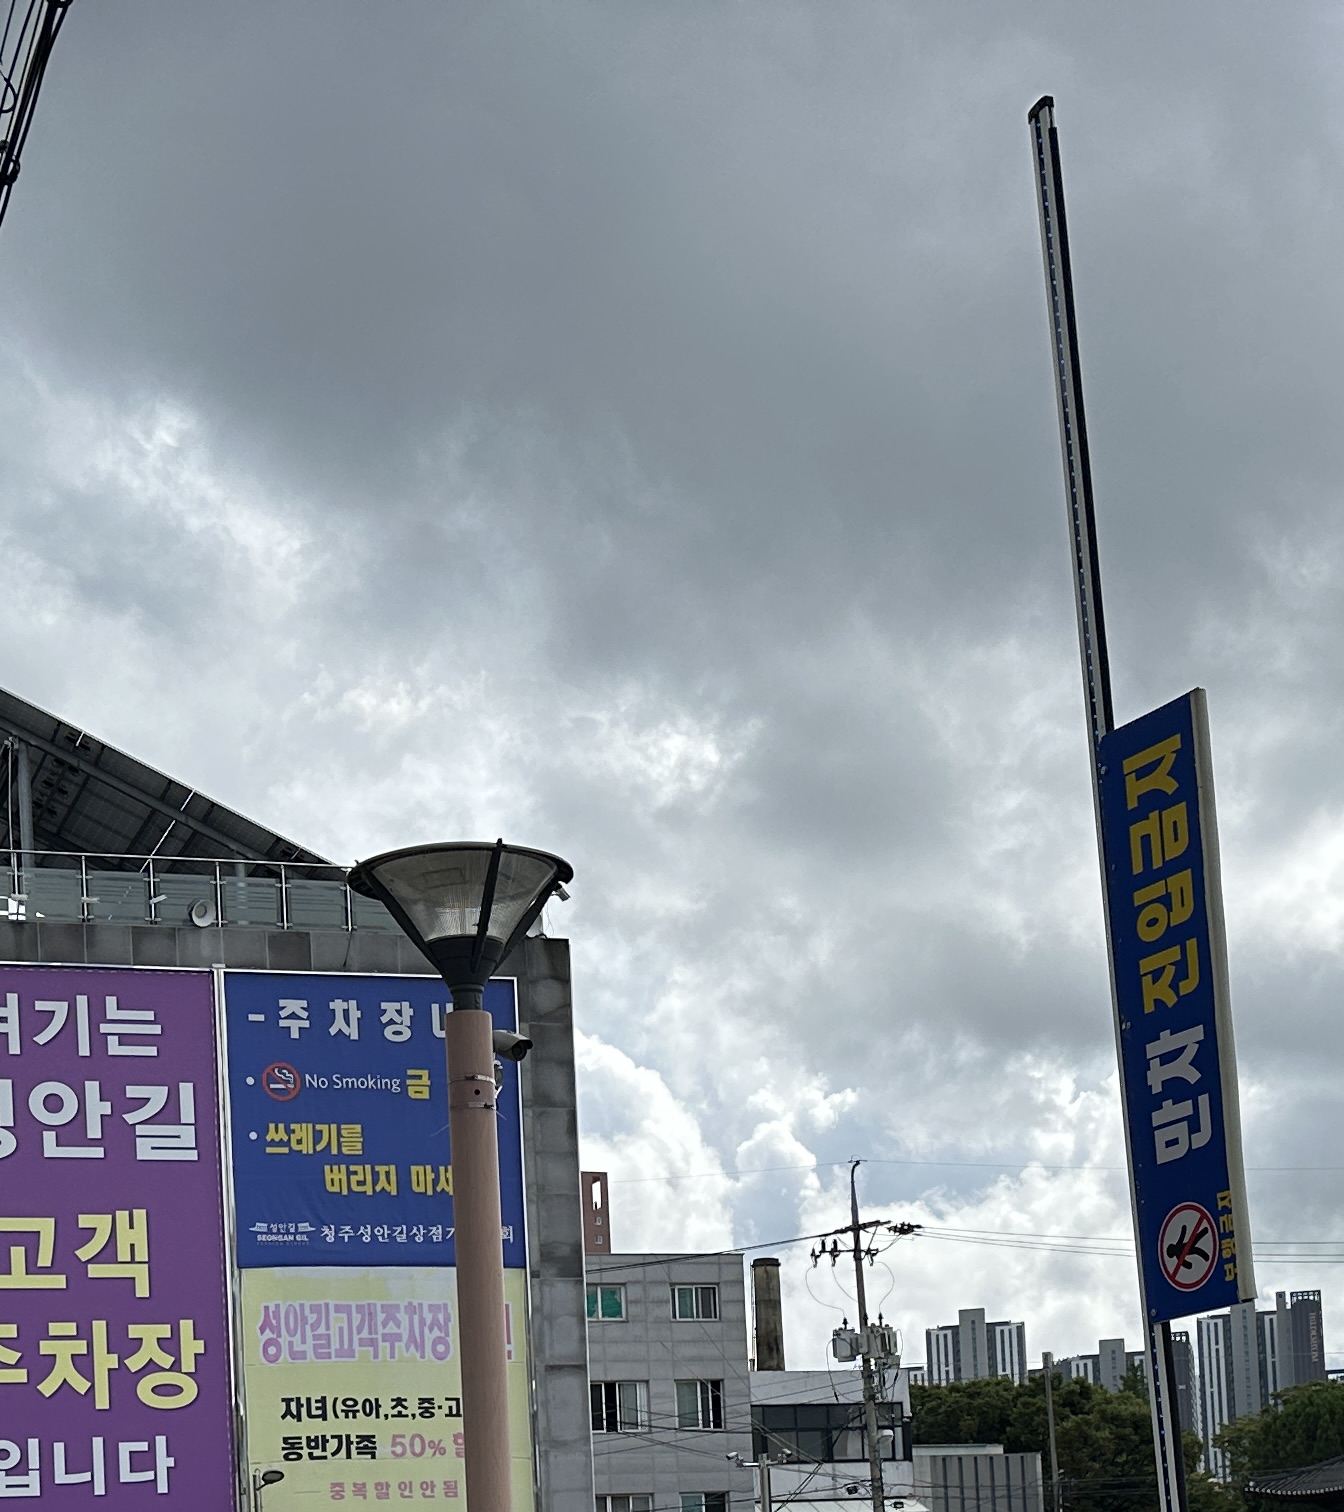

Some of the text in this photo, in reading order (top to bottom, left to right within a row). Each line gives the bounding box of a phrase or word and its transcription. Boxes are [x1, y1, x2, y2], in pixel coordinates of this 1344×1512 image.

[1122, 733, 1212, 1165] 만차 진입금지
[306, 1074, 328, 1089] No
[332, 1073, 401, 1093] Smoking
[265, 1123, 364, 1155] 쓰레기를
[324, 1165, 398, 1196] 버리지
[269, 1222, 296, 1233] 성안길
[258, 1302, 452, 1363] 성안길고객주차장
[281, 1433, 377, 1461] 동반가족
[390, 1432, 446, 1458] 50%
